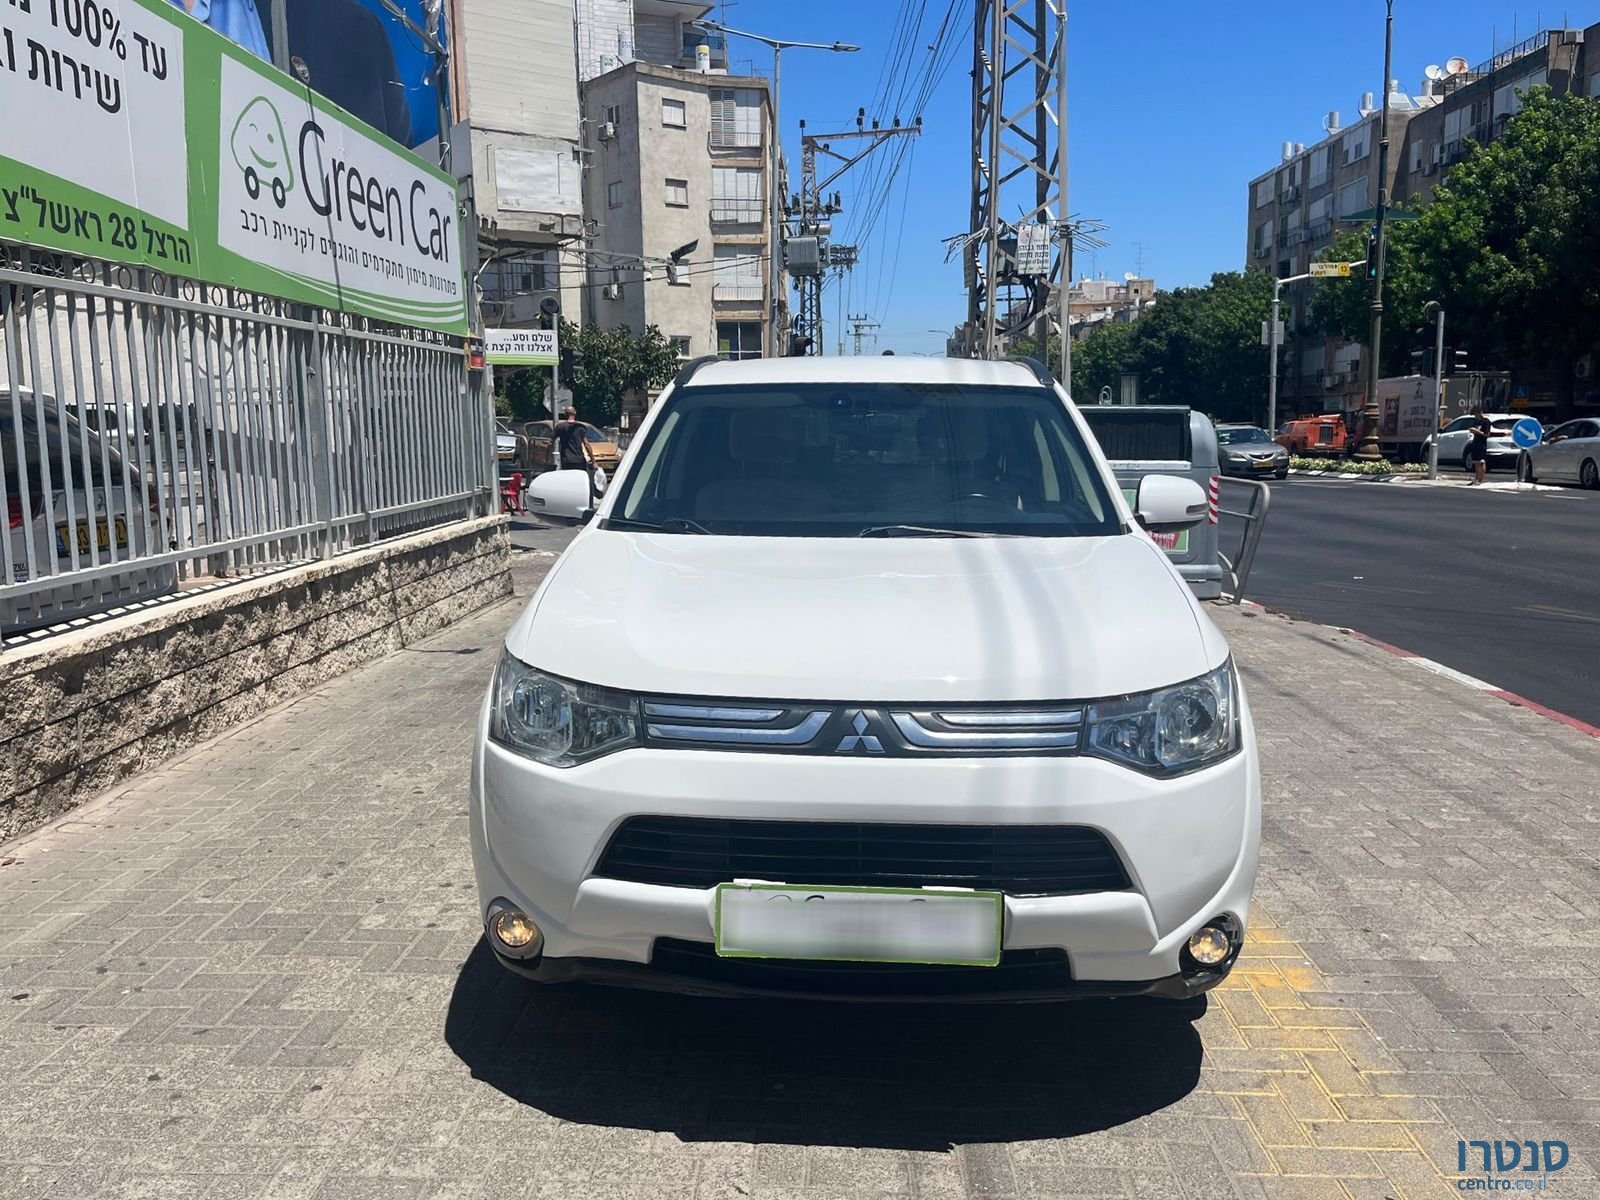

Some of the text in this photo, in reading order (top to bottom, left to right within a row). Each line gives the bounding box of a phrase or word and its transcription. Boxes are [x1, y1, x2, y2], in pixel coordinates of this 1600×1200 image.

[50, 0, 167, 80] עד 100%
[27, 38, 121, 113] שירות
[299, 120, 451, 263] Green Car
[109, 212, 137, 250] 28
[142, 219, 191, 264] הרצל
[240, 208, 457, 295] פתרונות מימון מתקדמים והוגנים לקניית רכב
[491, 343, 512, 353] קצת
[503, 333, 553, 342] שלם וסע...
[514, 343, 525, 352] זה
[527, 343, 553, 352] אצלנו
